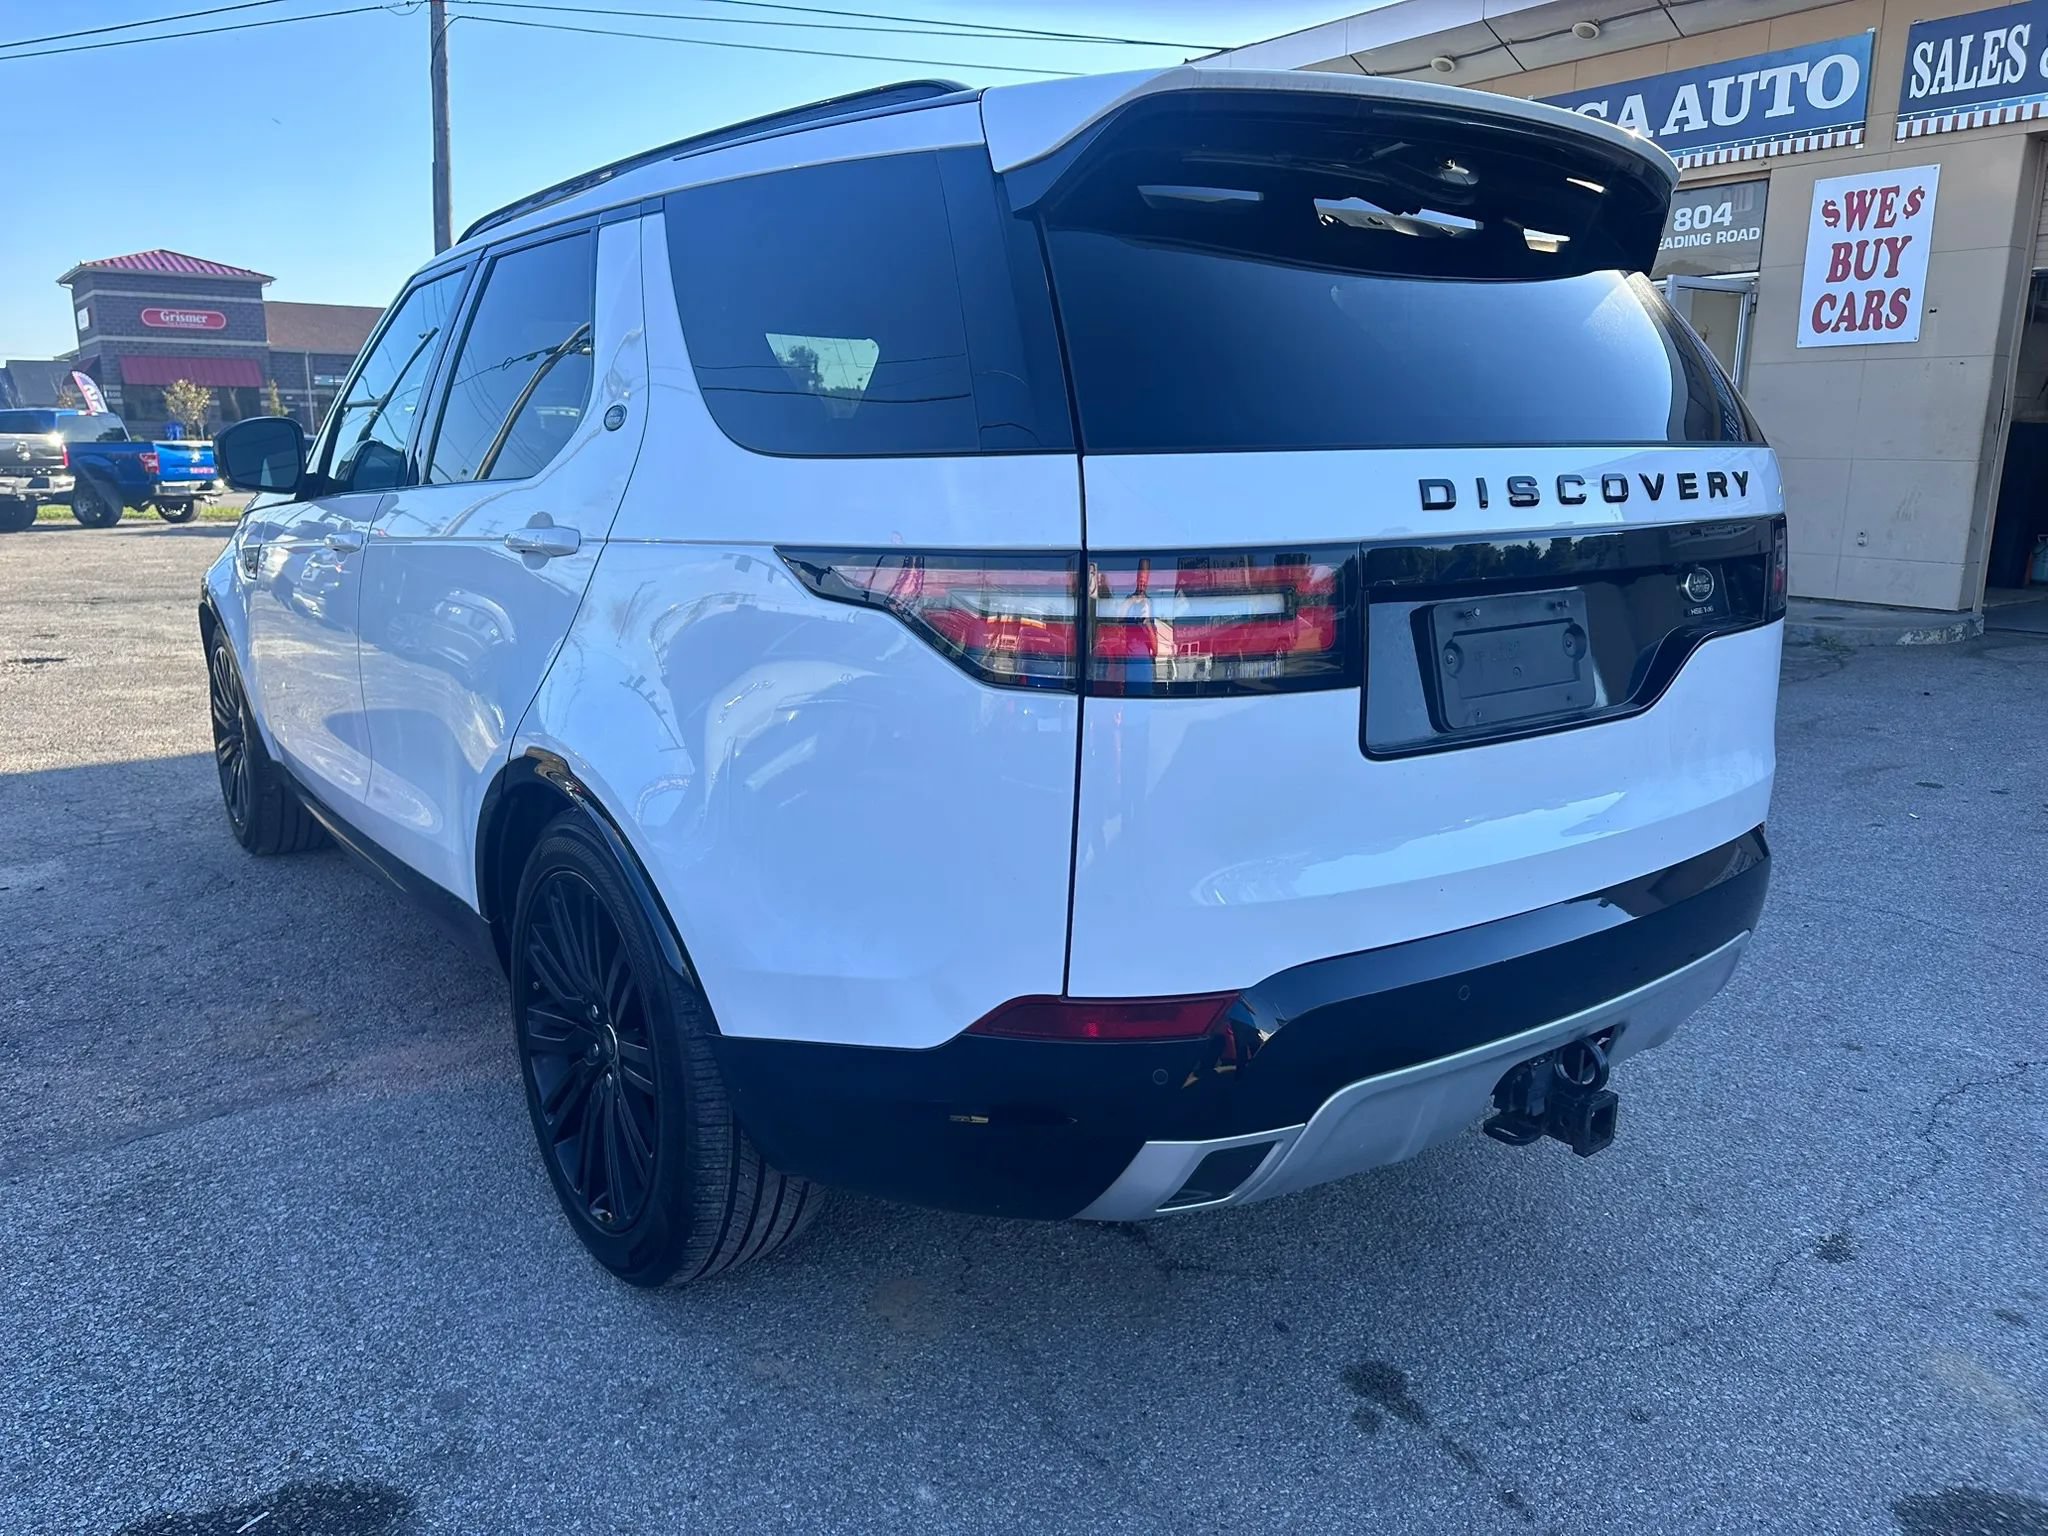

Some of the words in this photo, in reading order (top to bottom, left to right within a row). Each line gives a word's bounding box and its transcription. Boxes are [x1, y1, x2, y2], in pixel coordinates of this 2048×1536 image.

[1909, 24, 2031, 99] SALES
[1659, 54, 1860, 136] AUTO
[1658, 233, 1712, 250] EADING
[1716, 227, 1760, 244] ROAD
[1673, 202, 1732, 232] 804
[1826, 235, 1912, 283] BUY
[160, 311, 208, 324] Grismer
[1812, 287, 1911, 334] CARS
[1418, 470, 1749, 511] DISCOVERY
